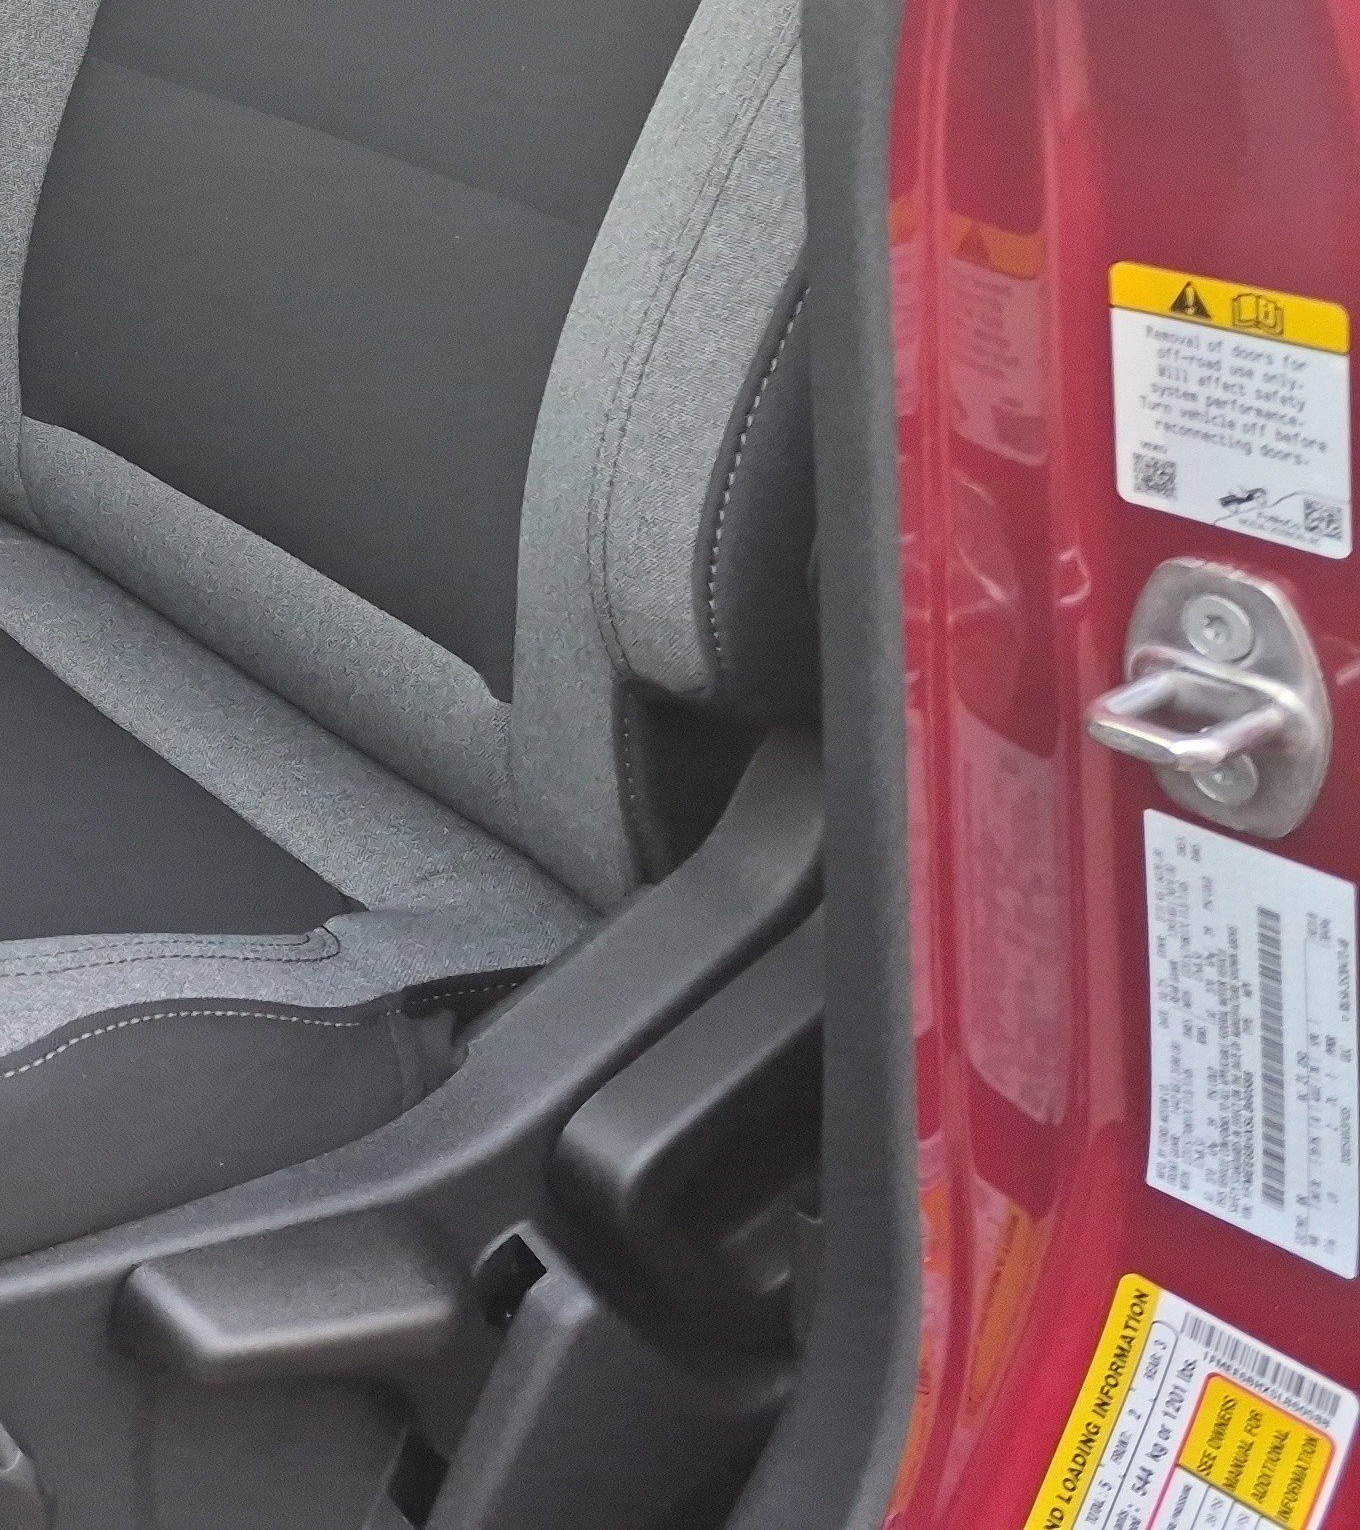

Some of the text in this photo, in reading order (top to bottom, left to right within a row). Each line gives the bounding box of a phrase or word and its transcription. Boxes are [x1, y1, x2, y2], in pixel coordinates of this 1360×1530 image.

[1146, 324, 1307, 370] Removal of doors for
[1157, 348, 1222, 372] off-road
[1230, 366, 1254, 379] use
[1151, 383, 1199, 402] system
[1158, 365, 1188, 383] Will
[1255, 388, 1306, 413] safety
[1140, 394, 1328, 453] Turn vehicle off before
[1155, 420, 1253, 456] reconnecting
[1154, 1339, 1166, 1350] 3
[1045, 1289, 1149, 1530] ND LOADING INFORMATION
[1128, 1408, 1141, 1420] 2
[1163, 1384, 1187, 1420] 1201
[1157, 1423, 1172, 1441] or
[1146, 1442, 1169, 1462] kg
[1197, 1449, 1217, 1476] SEE
[1222, 1439, 1254, 1492] MANUAL
[1244, 1409, 1263, 1437] FOR
[1250, 1429, 1290, 1504] ADDITIONAL
[1099, 1479, 1112, 1491] 5
[1131, 1466, 1155, 1497] 544
[1277, 1434, 1319, 1522] INFORMATION
